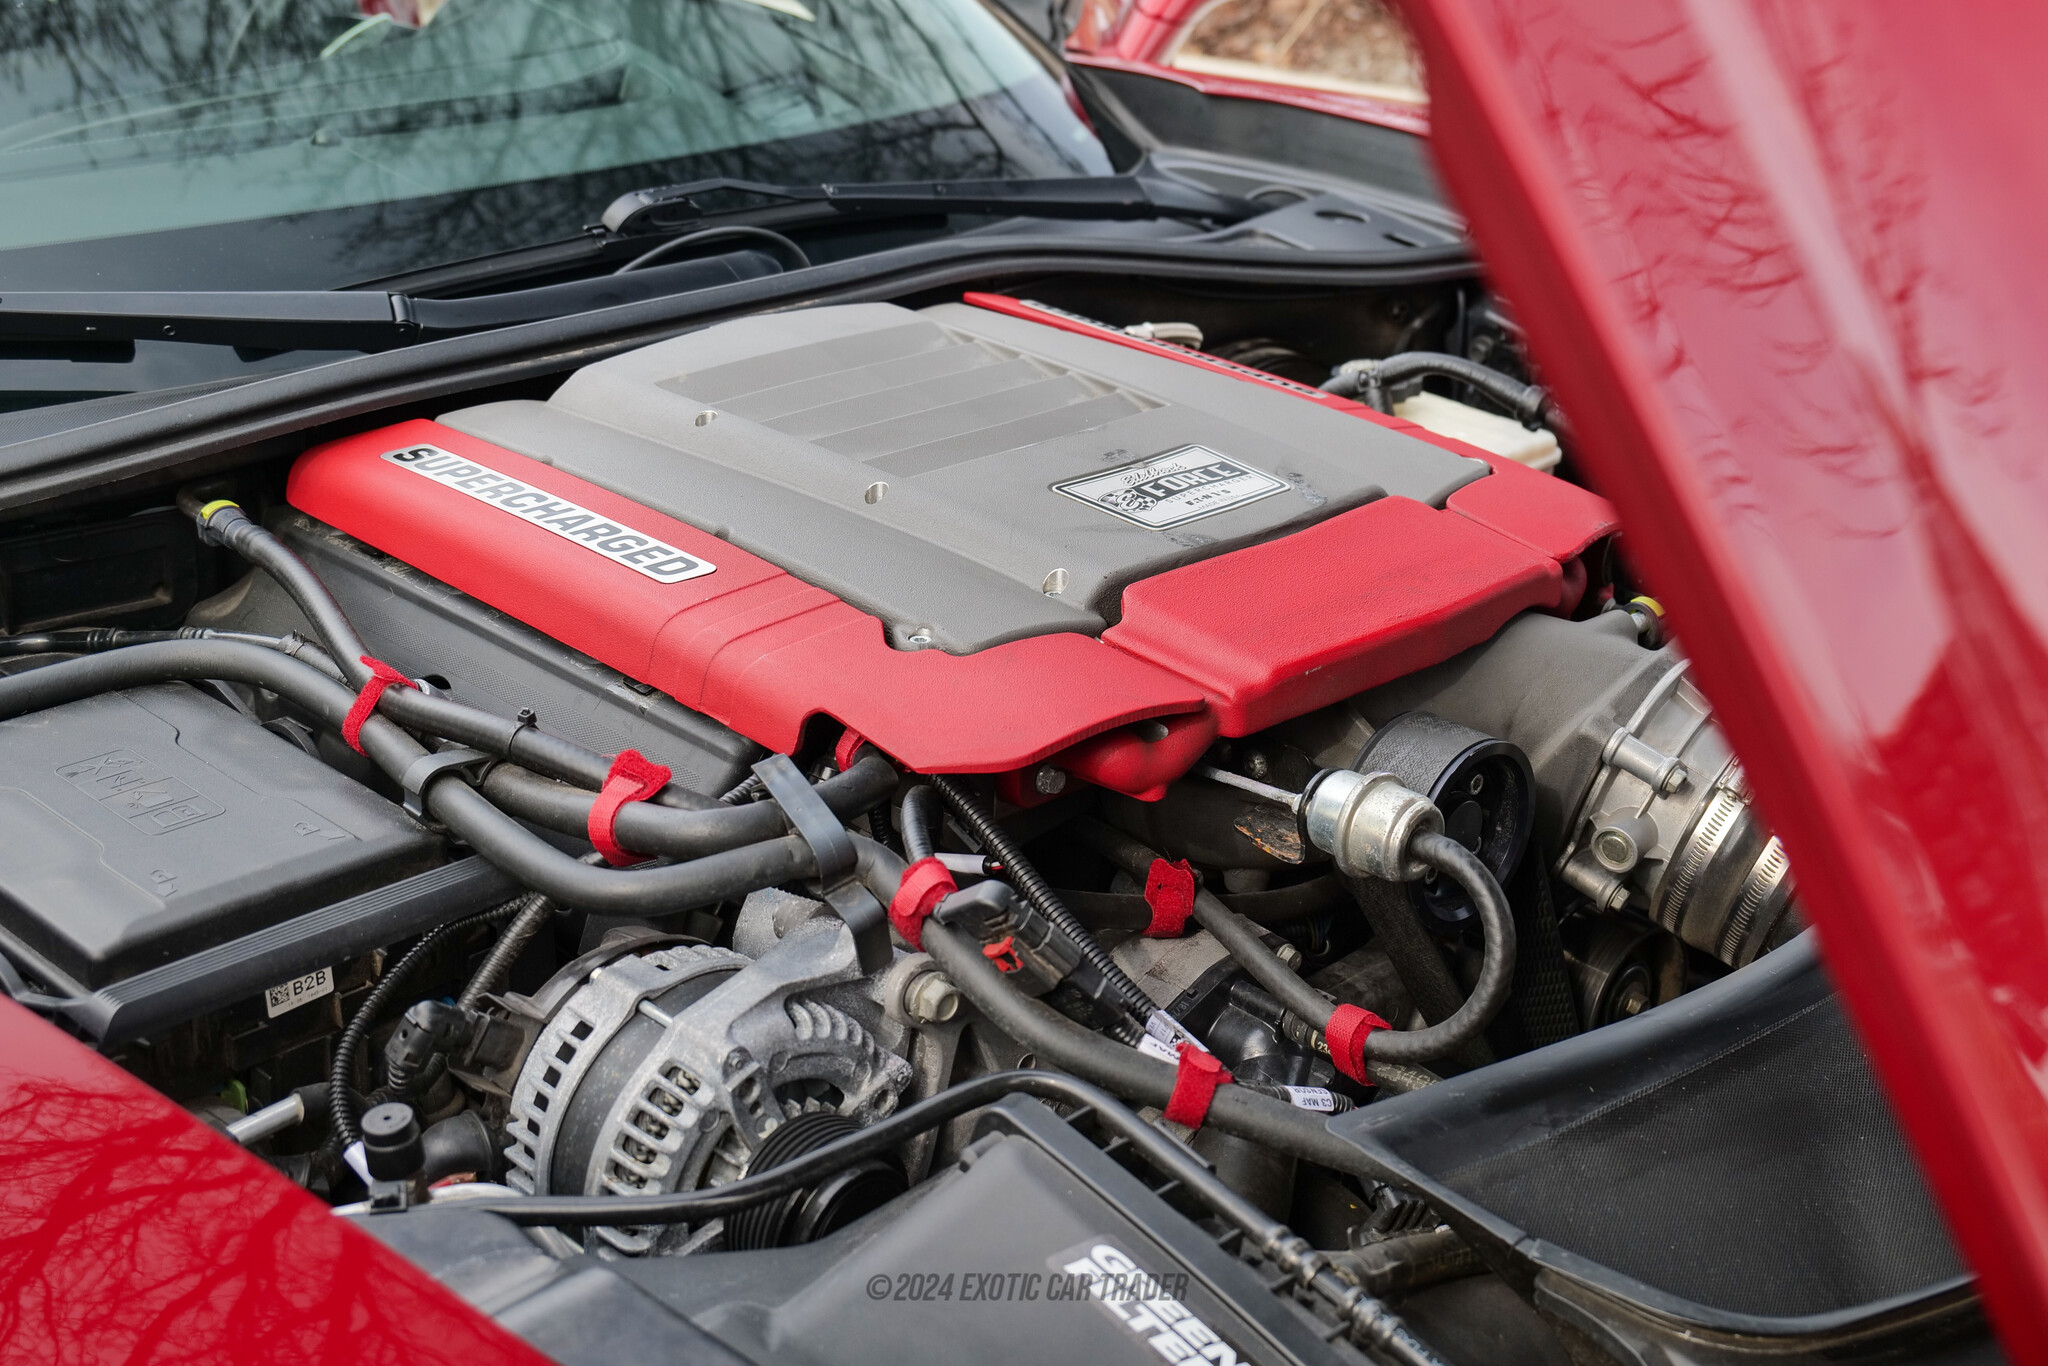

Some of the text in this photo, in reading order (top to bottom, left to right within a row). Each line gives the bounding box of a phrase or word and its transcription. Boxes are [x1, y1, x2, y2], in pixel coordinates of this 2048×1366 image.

[1140, 464, 1242, 497] FORCE
[393, 448, 699, 576] SUPERCHARGED
[293, 970, 327, 996] B2B
[1303, 1097, 1319, 1107] MAF
